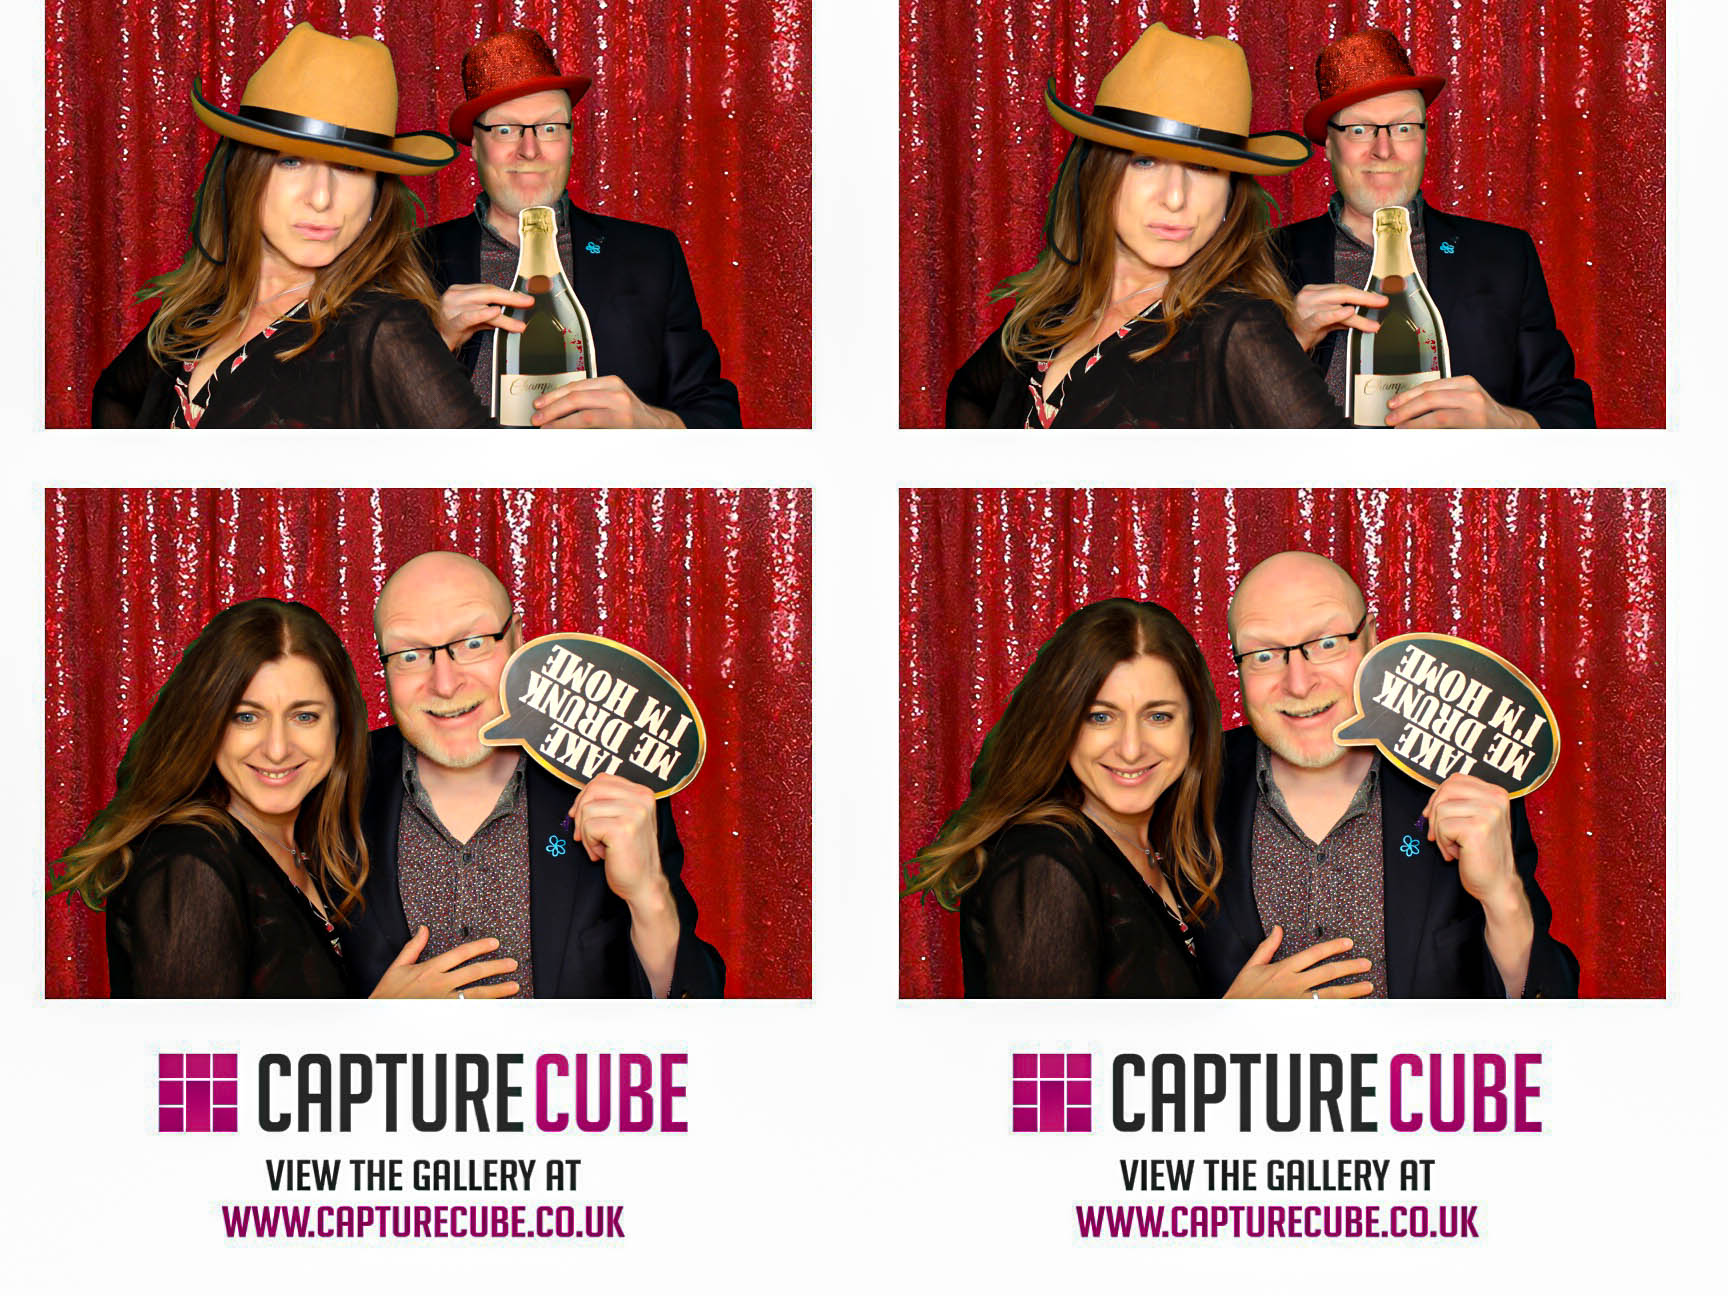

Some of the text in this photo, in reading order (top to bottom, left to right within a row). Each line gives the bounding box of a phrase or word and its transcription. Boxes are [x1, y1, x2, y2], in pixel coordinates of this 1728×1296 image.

[518, 670, 682, 781] ME DRUNK
[541, 644, 693, 748] I'M HOME
[1372, 670, 1536, 781] ME DRUNK
[1395, 644, 1547, 748] I'M HOME
